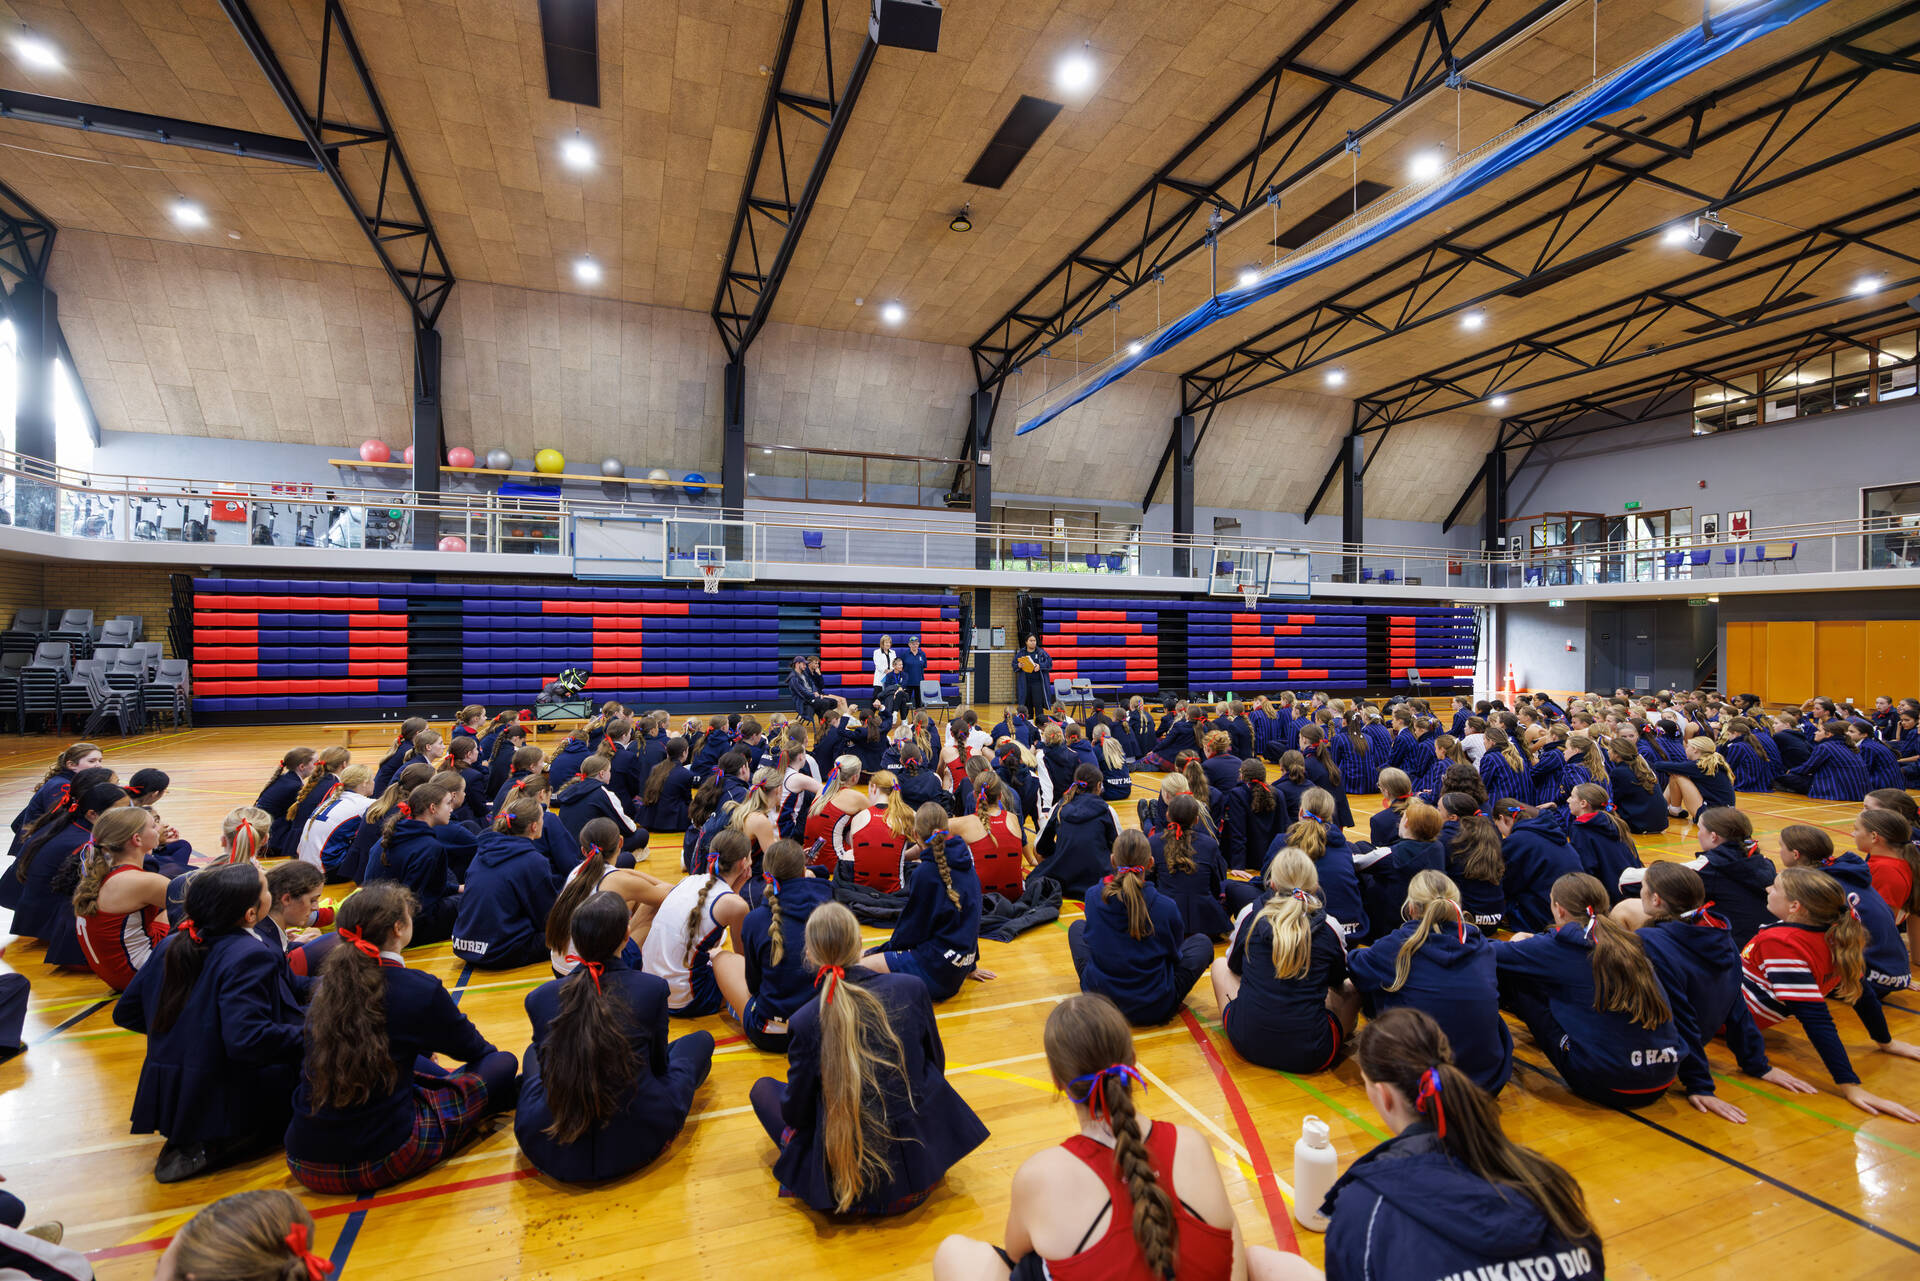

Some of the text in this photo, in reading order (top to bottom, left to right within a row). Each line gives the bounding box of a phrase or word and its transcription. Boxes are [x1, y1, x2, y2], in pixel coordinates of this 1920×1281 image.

[1866, 969, 1909, 988] POPPY
[1631, 1046, 1679, 1066] G HAY
[1556, 1247, 1592, 1279] DIO
